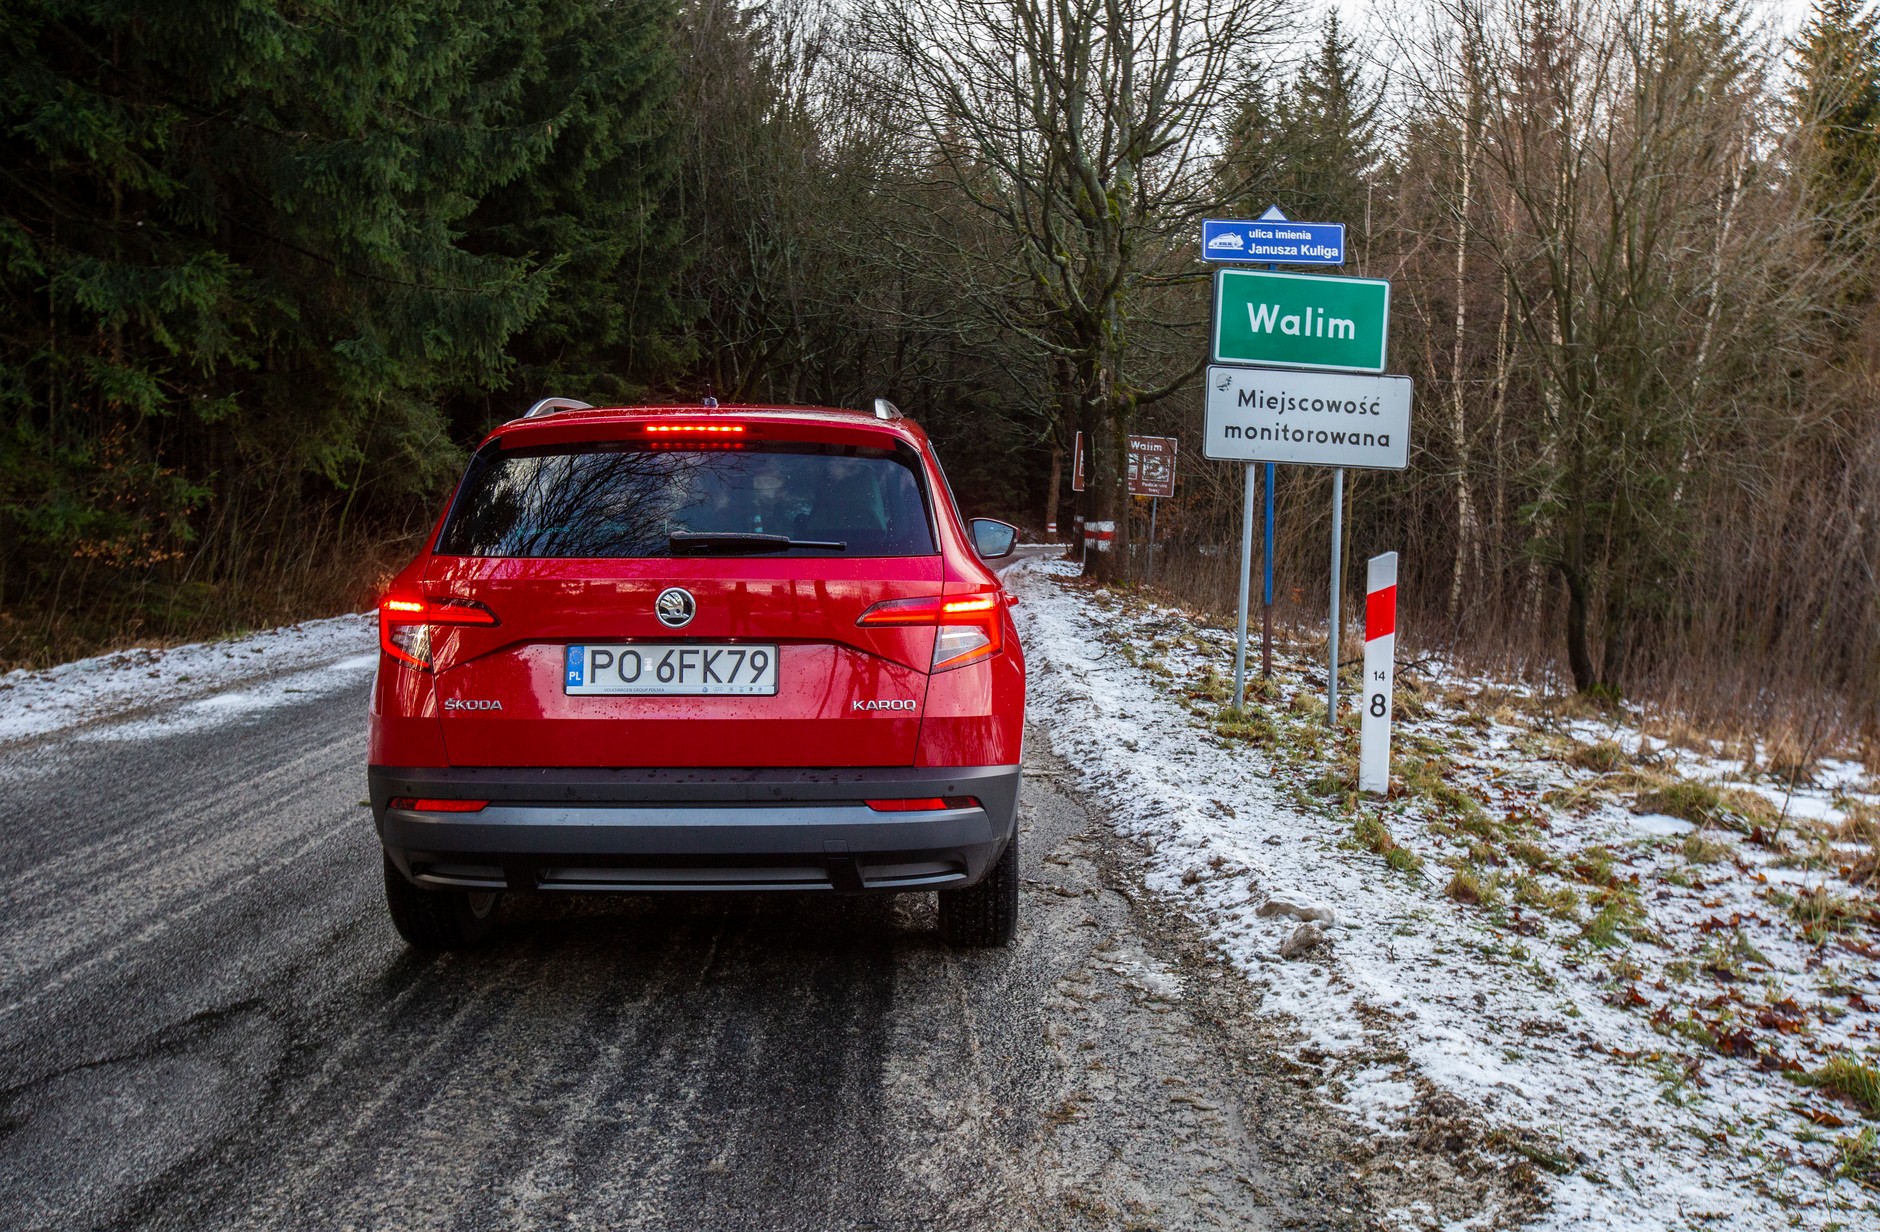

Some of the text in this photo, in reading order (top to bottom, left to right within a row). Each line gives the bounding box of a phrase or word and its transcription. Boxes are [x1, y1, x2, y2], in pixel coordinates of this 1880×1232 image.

[1248, 229, 1312, 240] ulica imienia
[1248, 243, 1339, 259] Janusza Kuliga
[1246, 302, 1356, 340] Walim
[1237, 388, 1381, 416] Miejscowość
[1224, 422, 1390, 448] monitorowana
[1130, 440, 1163, 452] Walim
[590, 649, 769, 684] PO 6FK79
[569, 671, 582, 681] PL
[1373, 670, 1386, 681] 14
[444, 697, 503, 711] ŠKODA
[853, 699, 917, 712] KAROQ
[1370, 693, 1387, 718] 8
